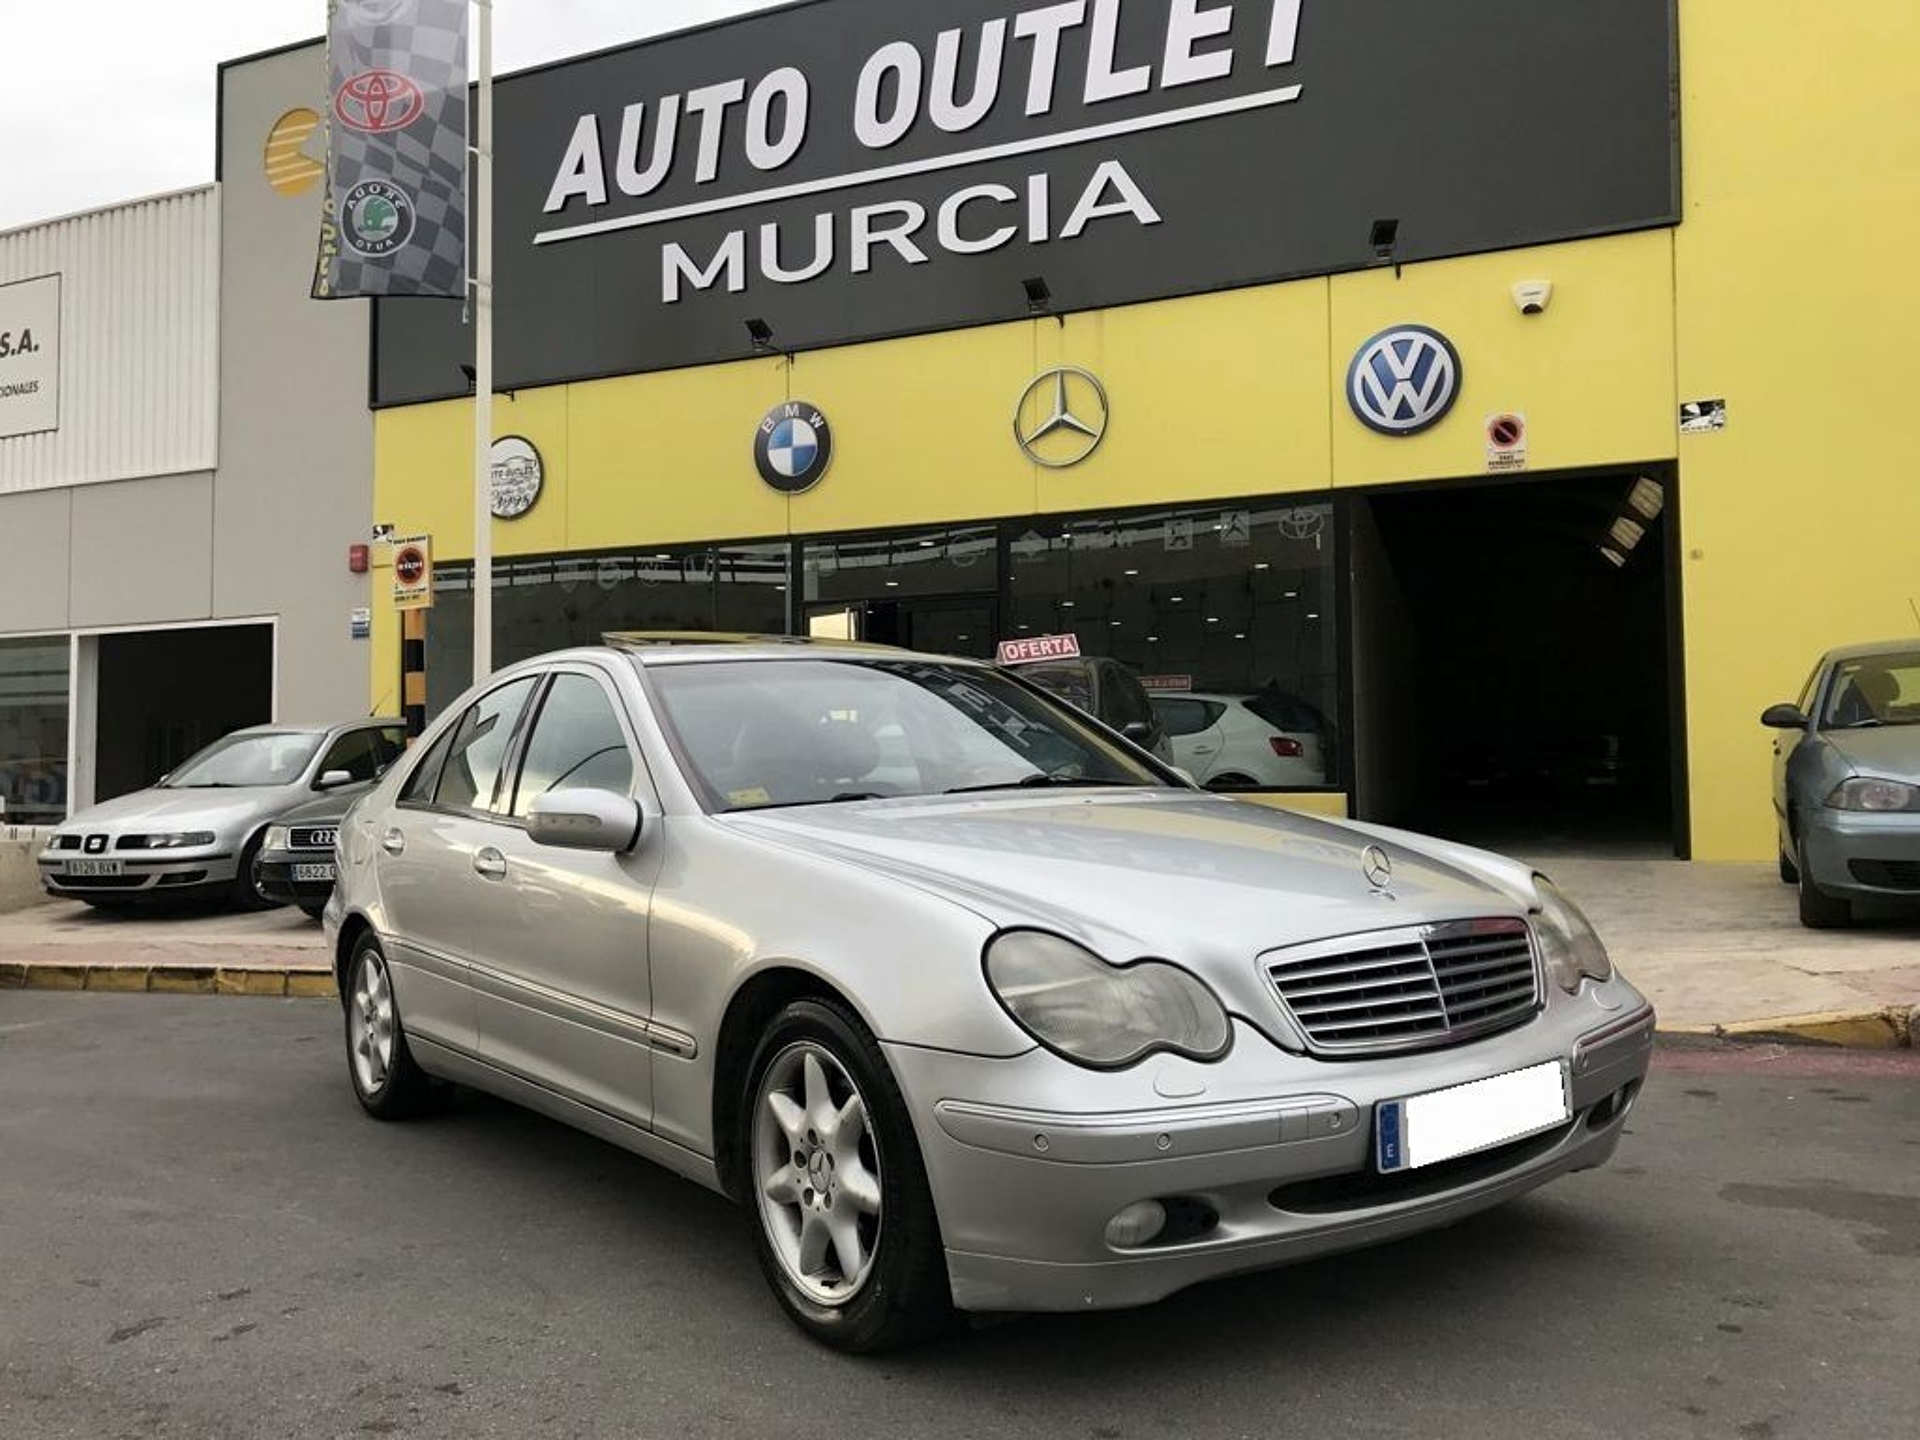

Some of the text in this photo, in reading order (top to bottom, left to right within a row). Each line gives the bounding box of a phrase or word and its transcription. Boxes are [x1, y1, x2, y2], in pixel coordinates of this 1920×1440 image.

[542, 67, 808, 213] AUTO
[661, 160, 1162, 303] MURCIA
[761, 403, 825, 434] BMW
[1006, 639, 1075, 659] OFERTA
[1387, 1143, 1395, 1158] E
